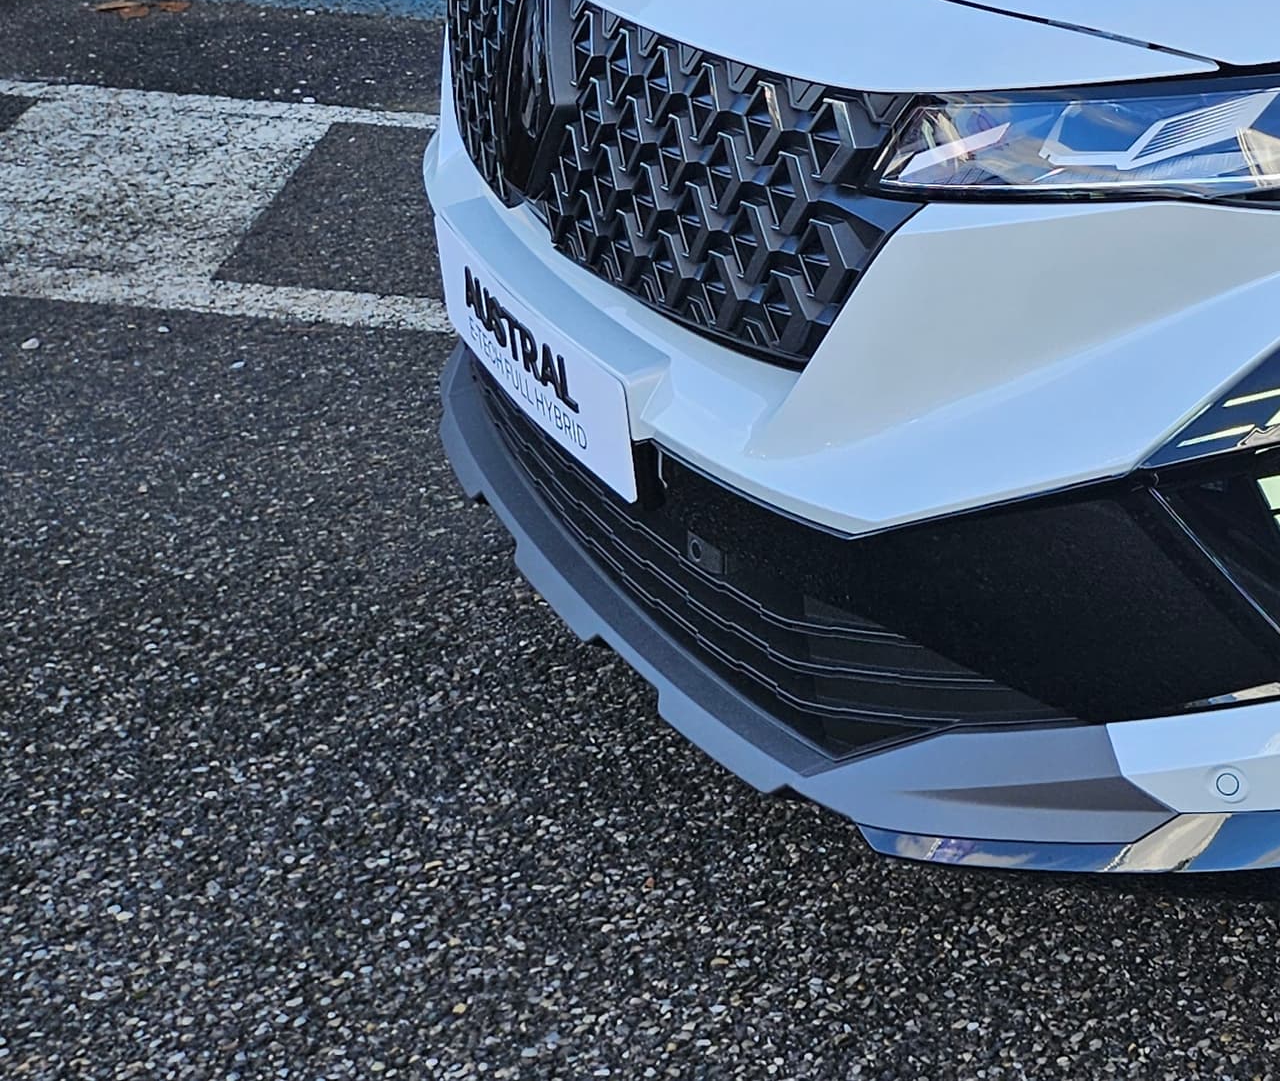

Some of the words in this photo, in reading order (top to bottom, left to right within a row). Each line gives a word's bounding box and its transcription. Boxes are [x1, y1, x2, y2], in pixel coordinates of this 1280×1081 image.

[464, 265, 580, 414] AUSTRAL
[468, 315, 505, 375] E-TECH
[506, 359, 534, 406] FULL
[534, 392, 588, 451] HYBRID
